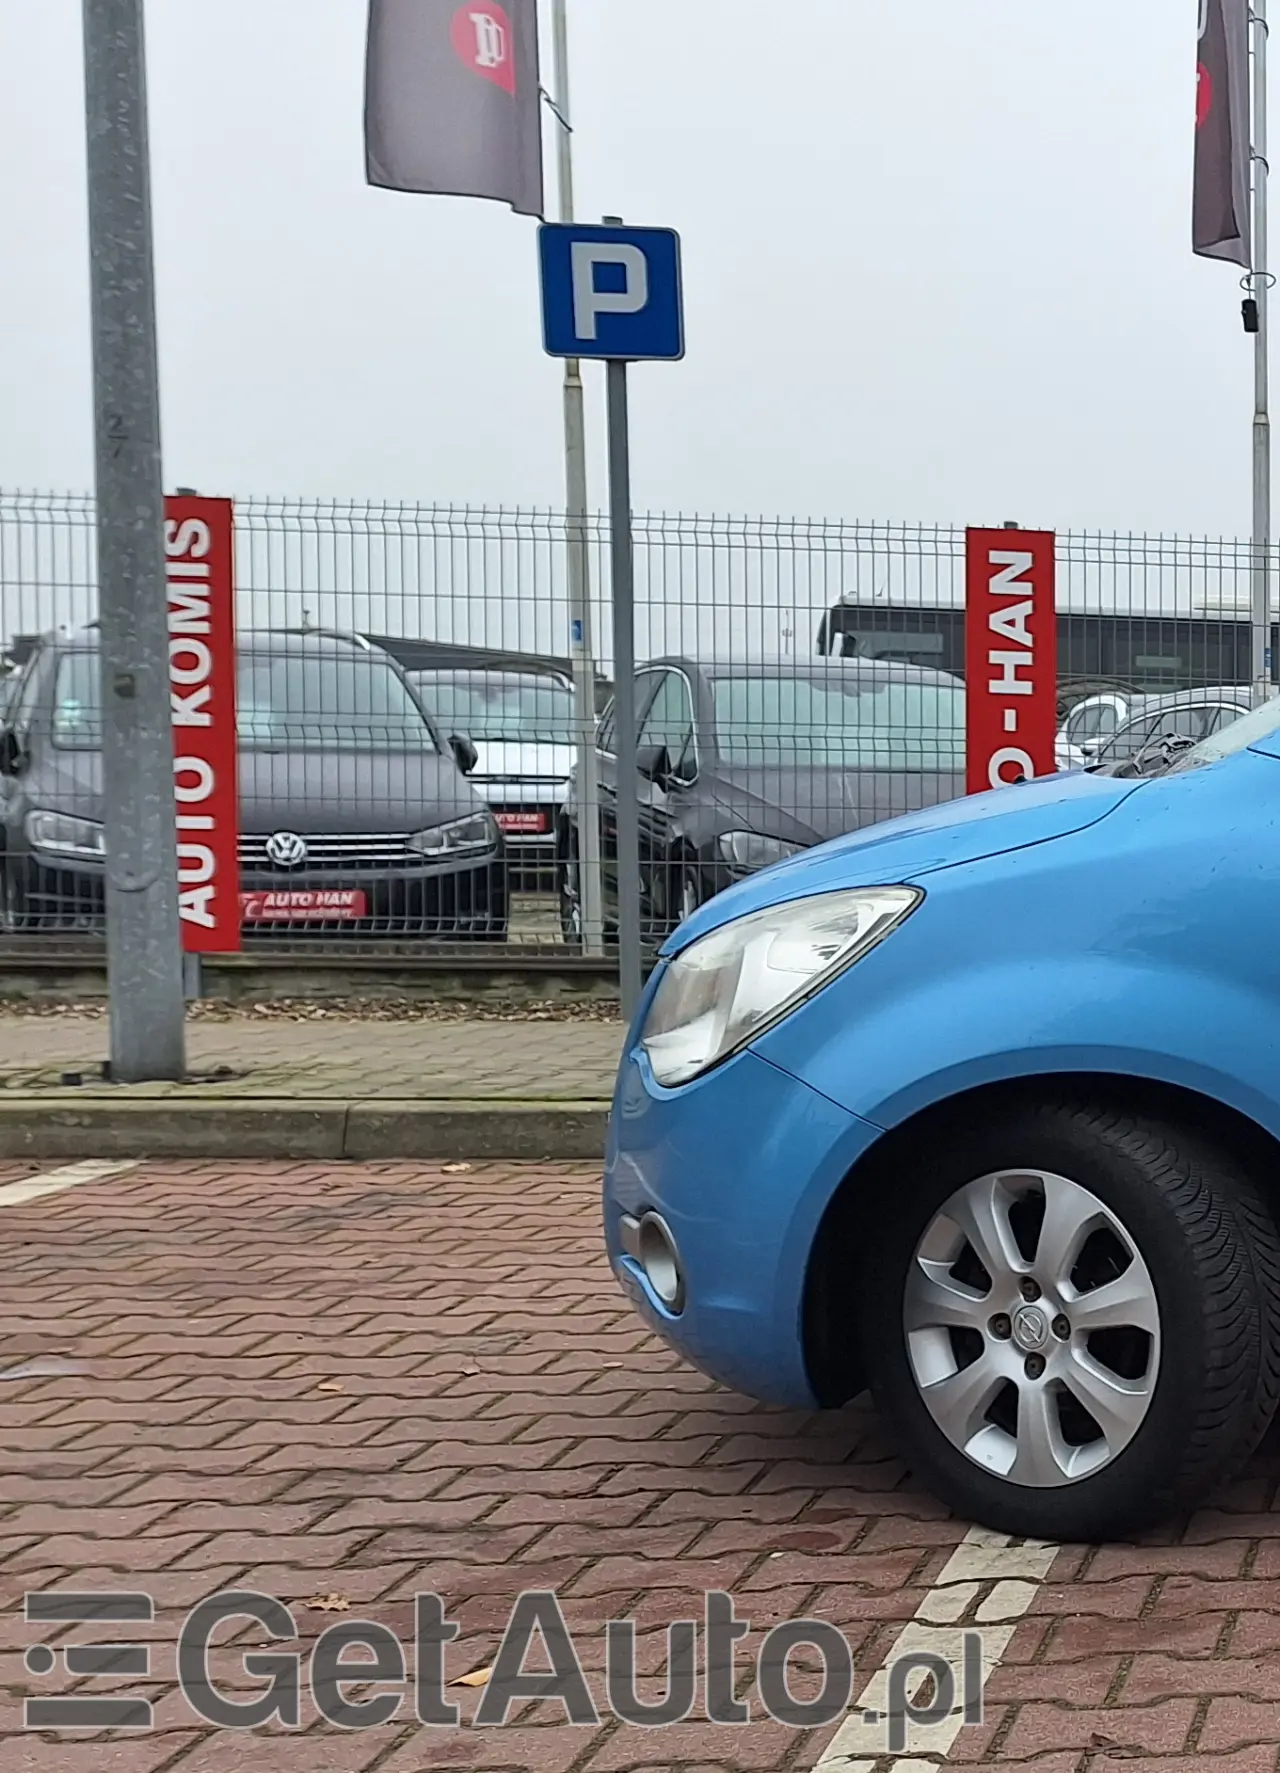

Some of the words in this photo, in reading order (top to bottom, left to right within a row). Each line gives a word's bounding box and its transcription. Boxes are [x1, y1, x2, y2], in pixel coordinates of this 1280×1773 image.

[570, 240, 649, 340] P
[163, 517, 213, 728] KOMIS
[173, 755, 216, 929] AUTO
[263, 891, 313, 907] AUTO
